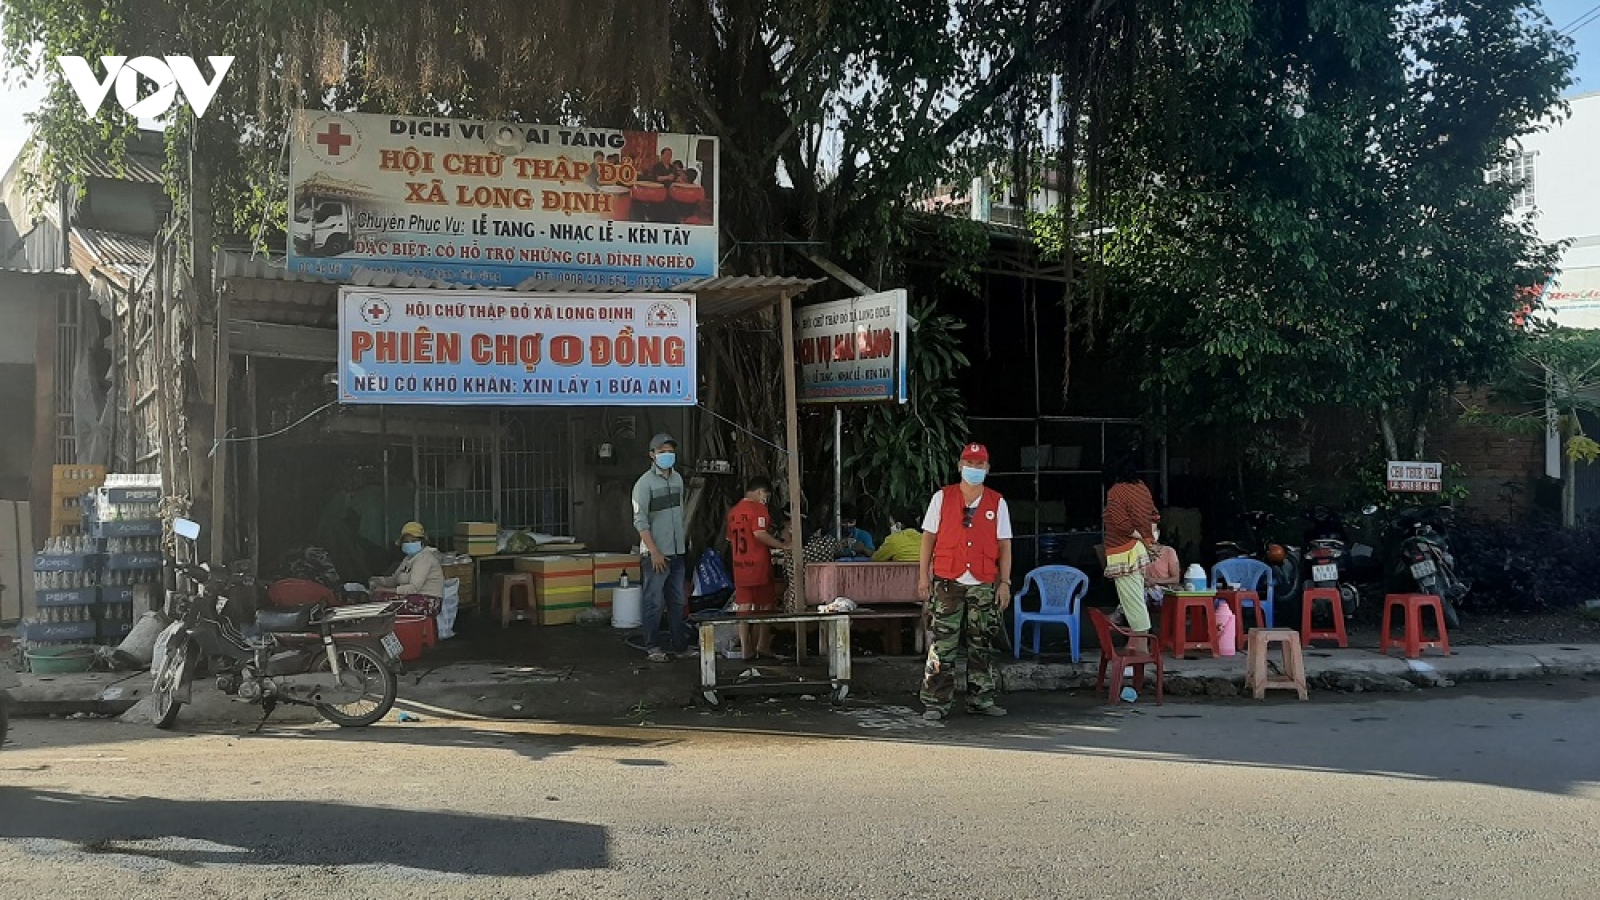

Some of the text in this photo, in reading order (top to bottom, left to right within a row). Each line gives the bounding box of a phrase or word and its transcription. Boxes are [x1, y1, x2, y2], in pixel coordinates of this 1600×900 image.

[390, 119, 450, 140] DỊCH
[379, 146, 435, 176] HỘI
[442, 151, 505, 178] CHỮ
[514, 155, 591, 186] THẬP
[405, 179, 613, 216] XÃ LONG ĐỊNH
[472, 213, 487, 236] LỄ
[492, 220, 535, 238] TANG
[549, 223, 594, 244] NHẠC
[600, 221, 614, 242] LỄ
[663, 226, 692, 246] TÂY
[355, 239, 695, 270] ĐẶC BIỆT: CÓ HỖ TRỢ NHỮNG GIA ĐÌNH NGHÈO
[405, 301, 430, 320] HỘI
[435, 302, 467, 318] CHỮ
[469, 302, 506, 321] THẬP
[510, 302, 529, 319] ĐỎ
[534, 304, 553, 320] XÃ
[556, 306, 595, 320] LONG
[599, 306, 634, 323] ĐỊNH
[351, 326, 463, 364] PHIÊN
[471, 332, 544, 373] CHỢ
[590, 325, 686, 368] ĐỒNG
[354, 371, 389, 392] NẾU
[395, 374, 417, 393] CÓ
[423, 374, 457, 393] KHÓ
[523, 378, 552, 394] XIN
[558, 374, 589, 394] LẤY
[595, 379, 601, 394] 1
[609, 376, 643, 394] BỮA
[126, 491, 158, 499] PEPSI
[46, 592, 79, 601] PEPSI
